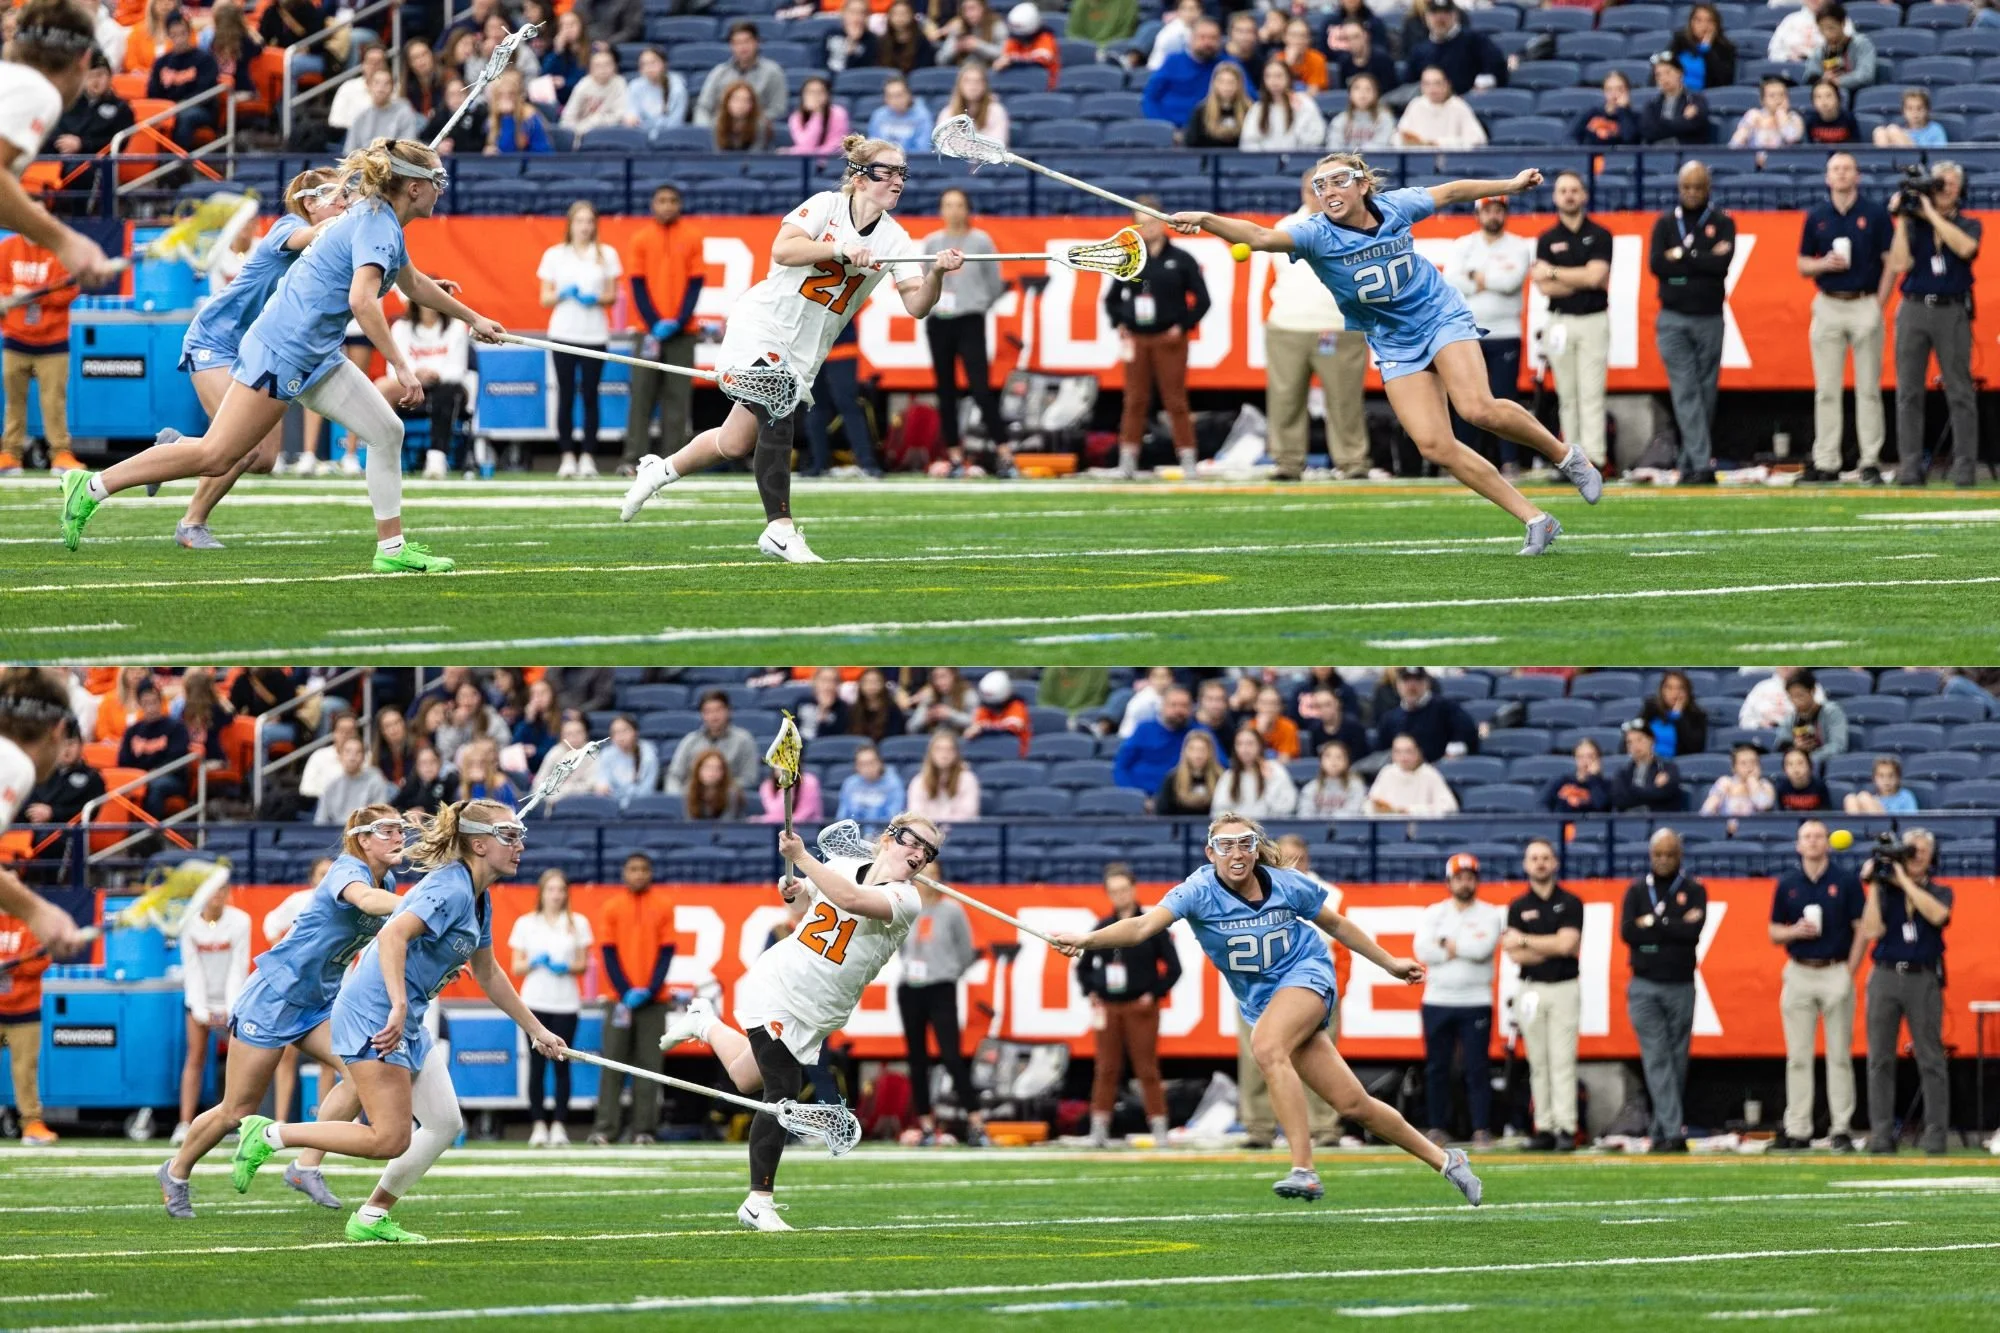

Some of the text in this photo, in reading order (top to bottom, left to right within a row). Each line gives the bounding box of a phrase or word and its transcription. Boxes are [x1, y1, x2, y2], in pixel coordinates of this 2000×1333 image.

[1343, 236, 1410, 267] CAROLINA
[799, 259, 867, 316] 21
[1353, 254, 1415, 304] 20
[797, 901, 859, 966] 21
[1219, 909, 1292, 931] CAROLINA
[1226, 928, 1292, 974] 20
